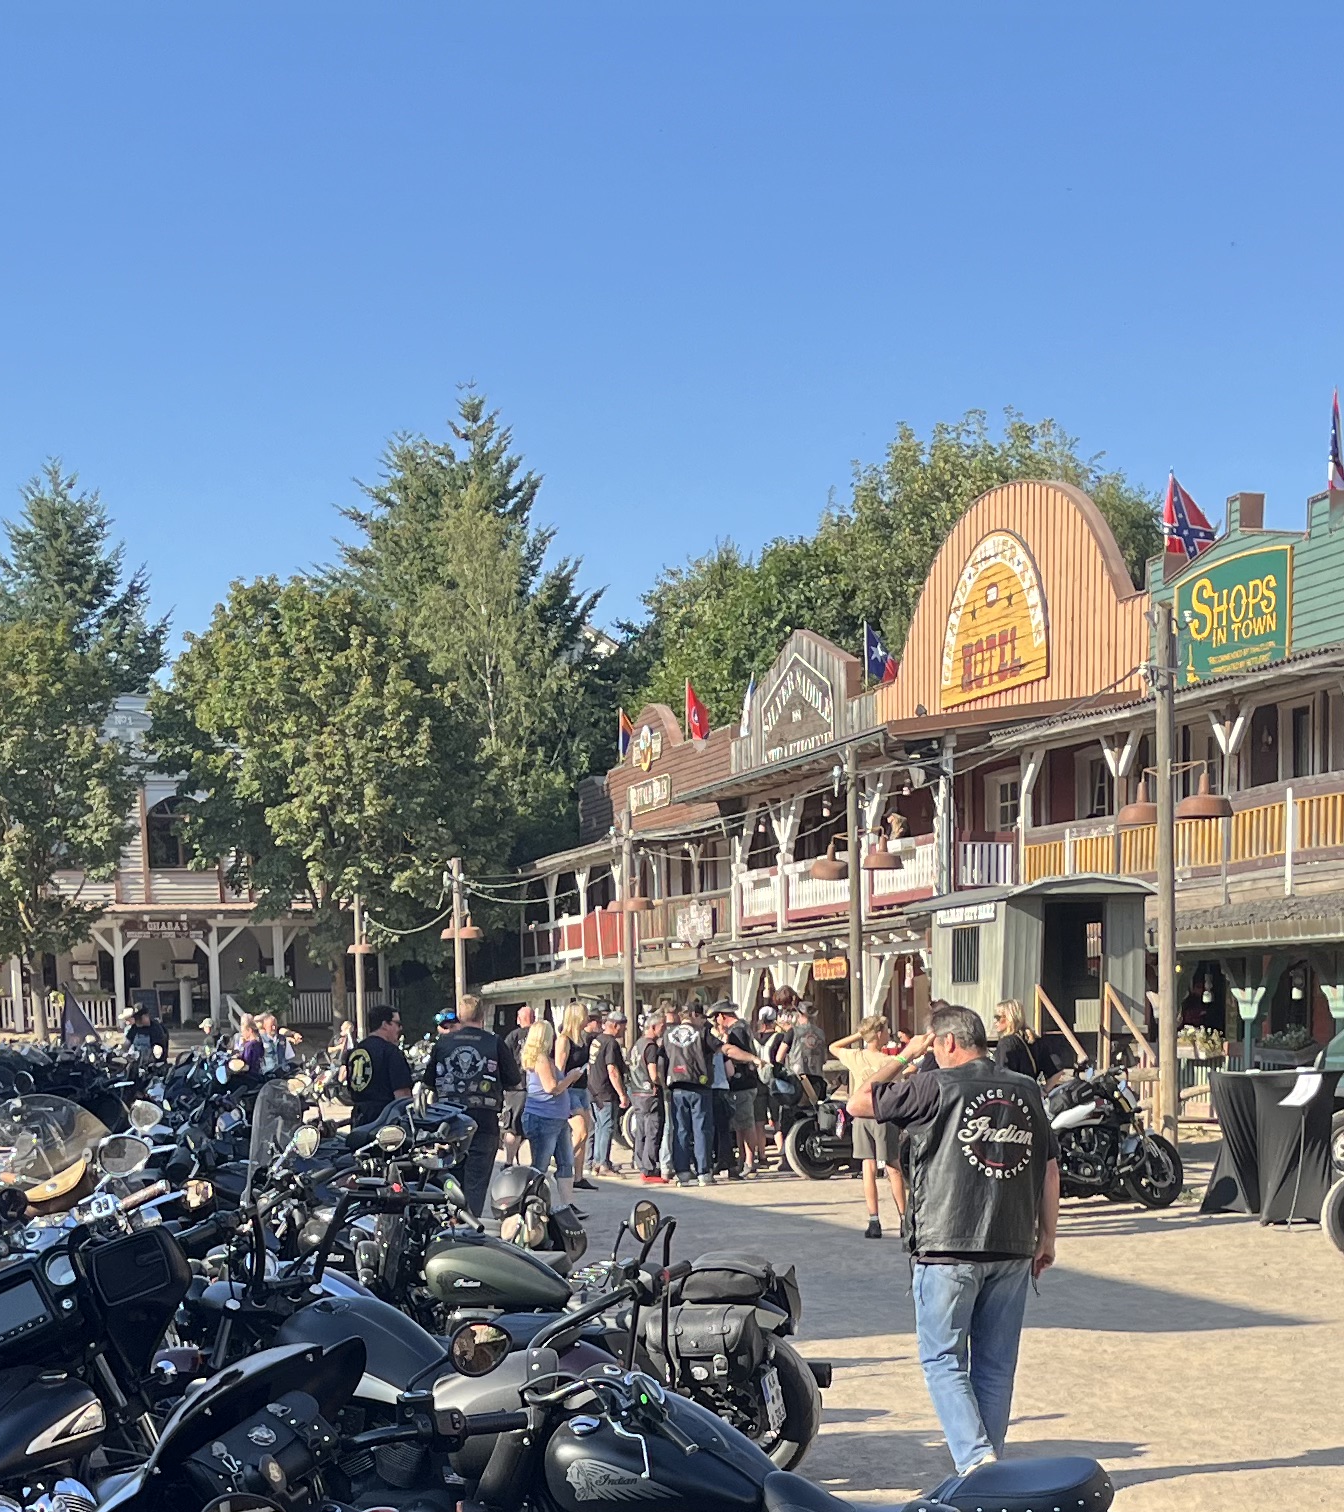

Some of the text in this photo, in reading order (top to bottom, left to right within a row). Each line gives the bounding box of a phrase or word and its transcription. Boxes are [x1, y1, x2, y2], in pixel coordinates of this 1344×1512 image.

[1189, 574, 1278, 641] SHOPS
[1212, 610, 1277, 648] IN TOWN
[960, 624, 1023, 693] HOTEL
[964, 1088, 1004, 1117] SINCE
[957, 1115, 1034, 1146] Indian
[961, 1144, 1033, 1180] MOTORCYCLE
[594, 1473, 638, 1487] Indian
